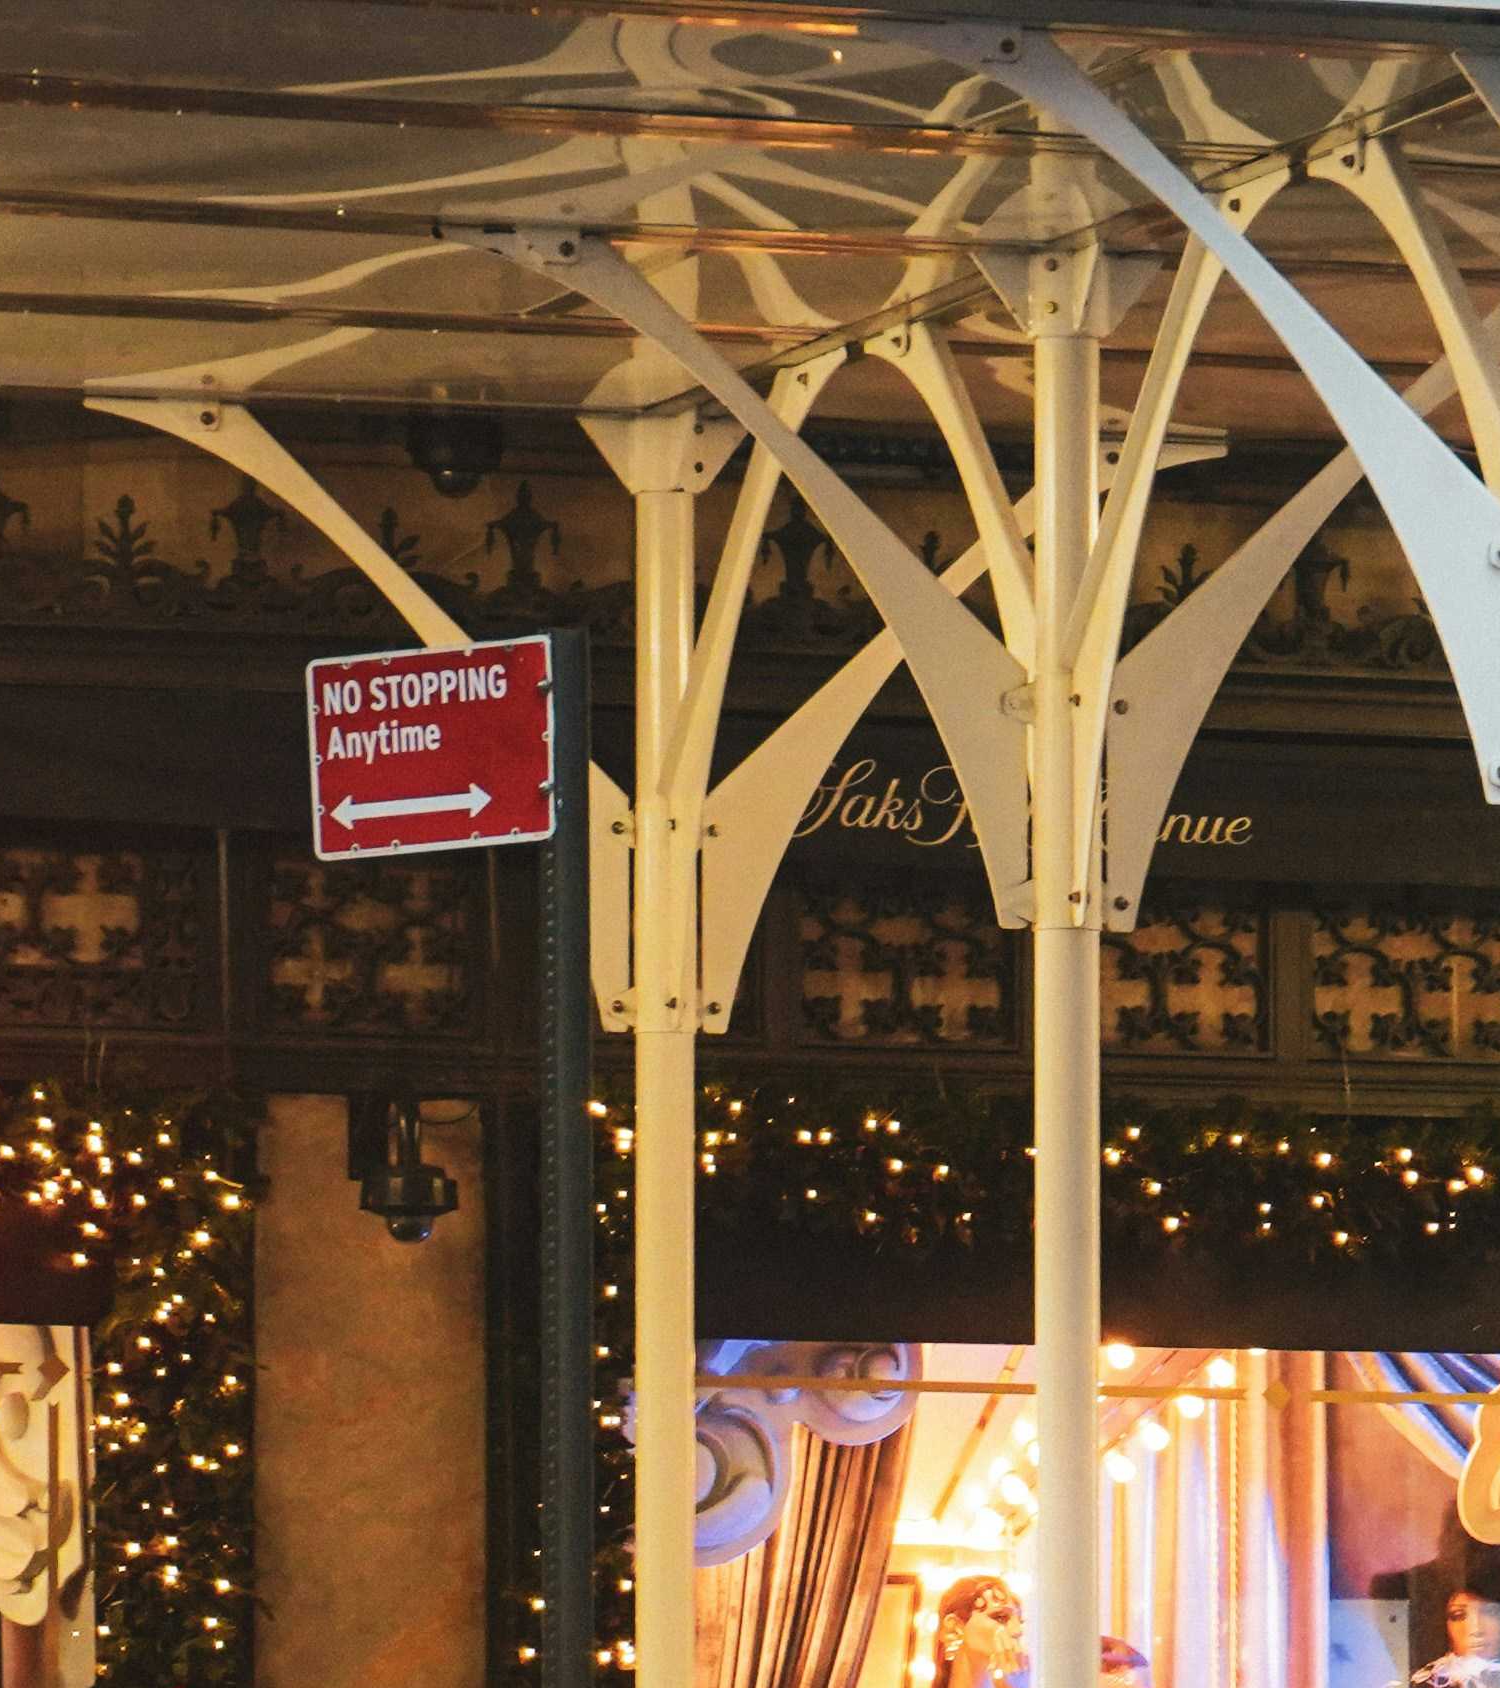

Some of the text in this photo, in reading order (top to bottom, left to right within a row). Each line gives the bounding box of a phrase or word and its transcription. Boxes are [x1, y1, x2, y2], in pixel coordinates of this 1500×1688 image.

[322, 664, 507, 716] NO STOPPING
[327, 719, 442, 765] Anytime
[793, 758, 924, 838] Saks
[1154, 812, 1255, 845] nue
